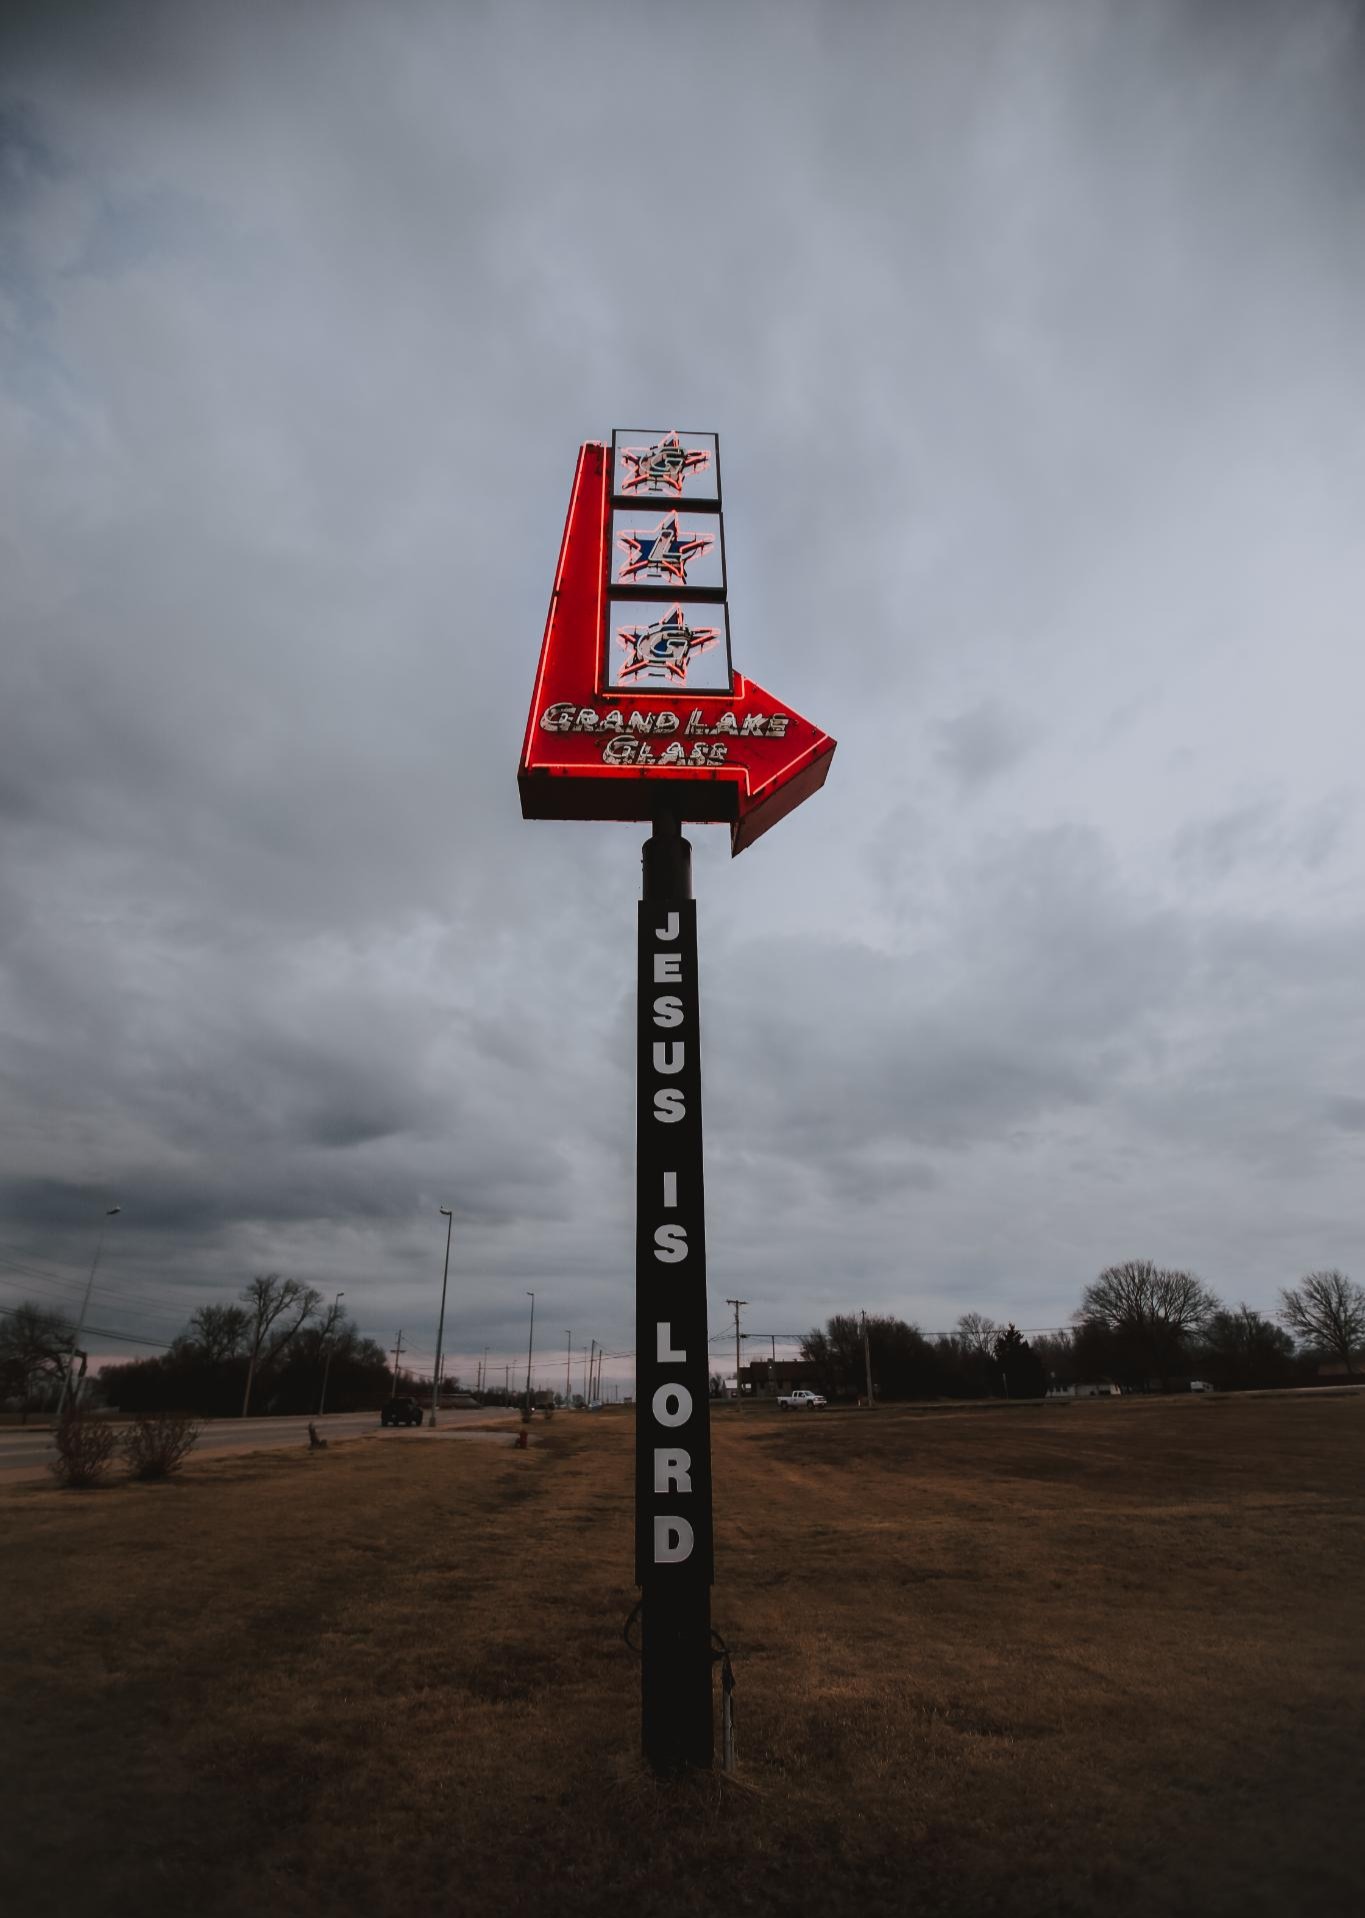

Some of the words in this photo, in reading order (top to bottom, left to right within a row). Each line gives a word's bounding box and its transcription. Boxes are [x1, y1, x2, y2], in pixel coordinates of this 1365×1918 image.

[639, 447, 684, 481] G
[647, 528, 682, 567] L
[636, 623, 691, 667] G
[540, 702, 680, 733] GRAND
[684, 708, 790, 737] LAKE
[603, 735, 728, 766] GLASS
[653, 912, 685, 1123] JESUS
[654, 1172, 688, 1263] IS
[652, 1322, 693, 1563] LORD
